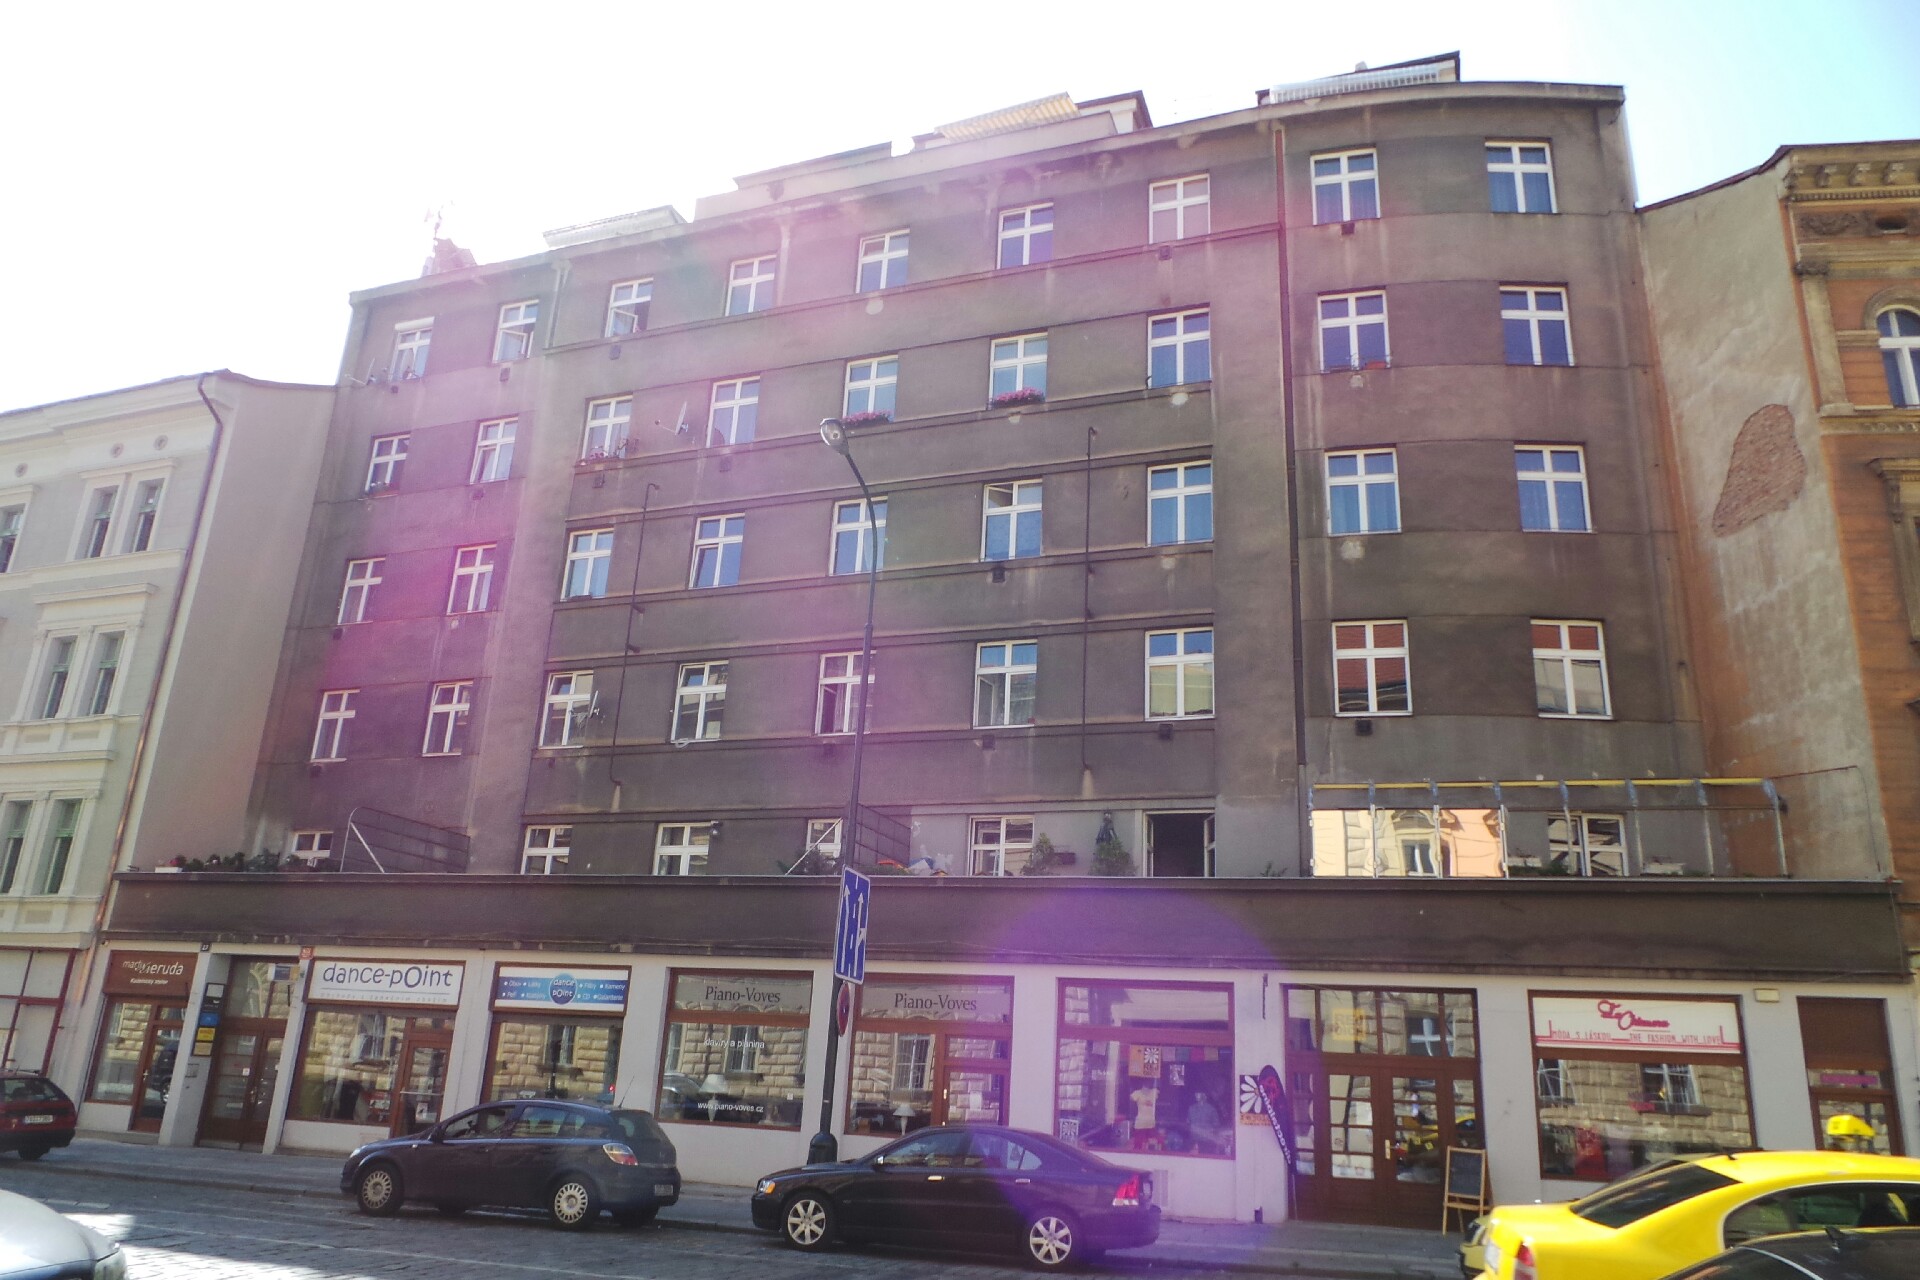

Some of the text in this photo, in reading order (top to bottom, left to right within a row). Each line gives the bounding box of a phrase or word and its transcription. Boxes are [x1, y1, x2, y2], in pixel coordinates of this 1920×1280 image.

[705, 985, 781, 1003] Piano-Voves
[894, 993, 977, 1011] Piano-Voves
[1629, 1033, 1641, 1042] THE
[1647, 1034, 1676, 1043] FASHION
[1681, 1034, 1698, 1043] WITH
